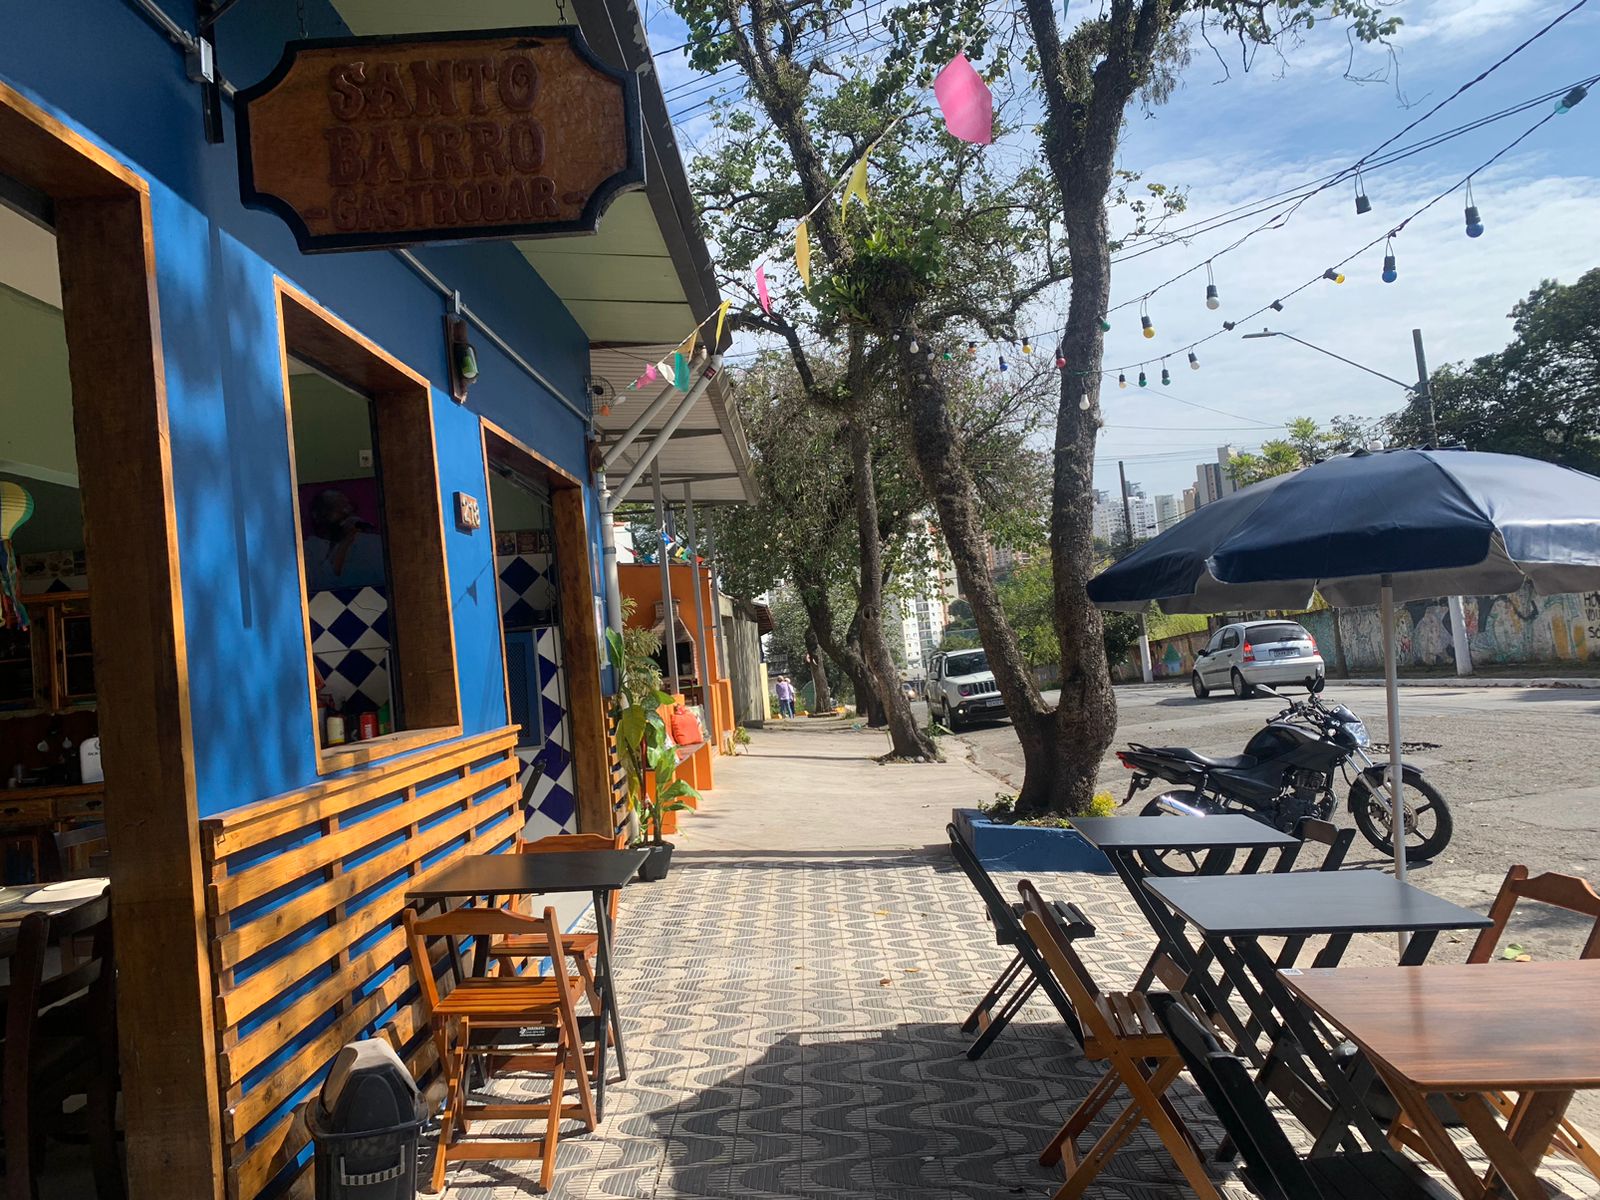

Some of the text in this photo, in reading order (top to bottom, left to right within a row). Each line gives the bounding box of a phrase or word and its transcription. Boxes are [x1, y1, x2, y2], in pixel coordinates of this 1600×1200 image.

[329, 56, 539, 121] SANTO
[325, 118, 545, 186] BAIRRO
[331, 176, 560, 231] GASTROBAR
